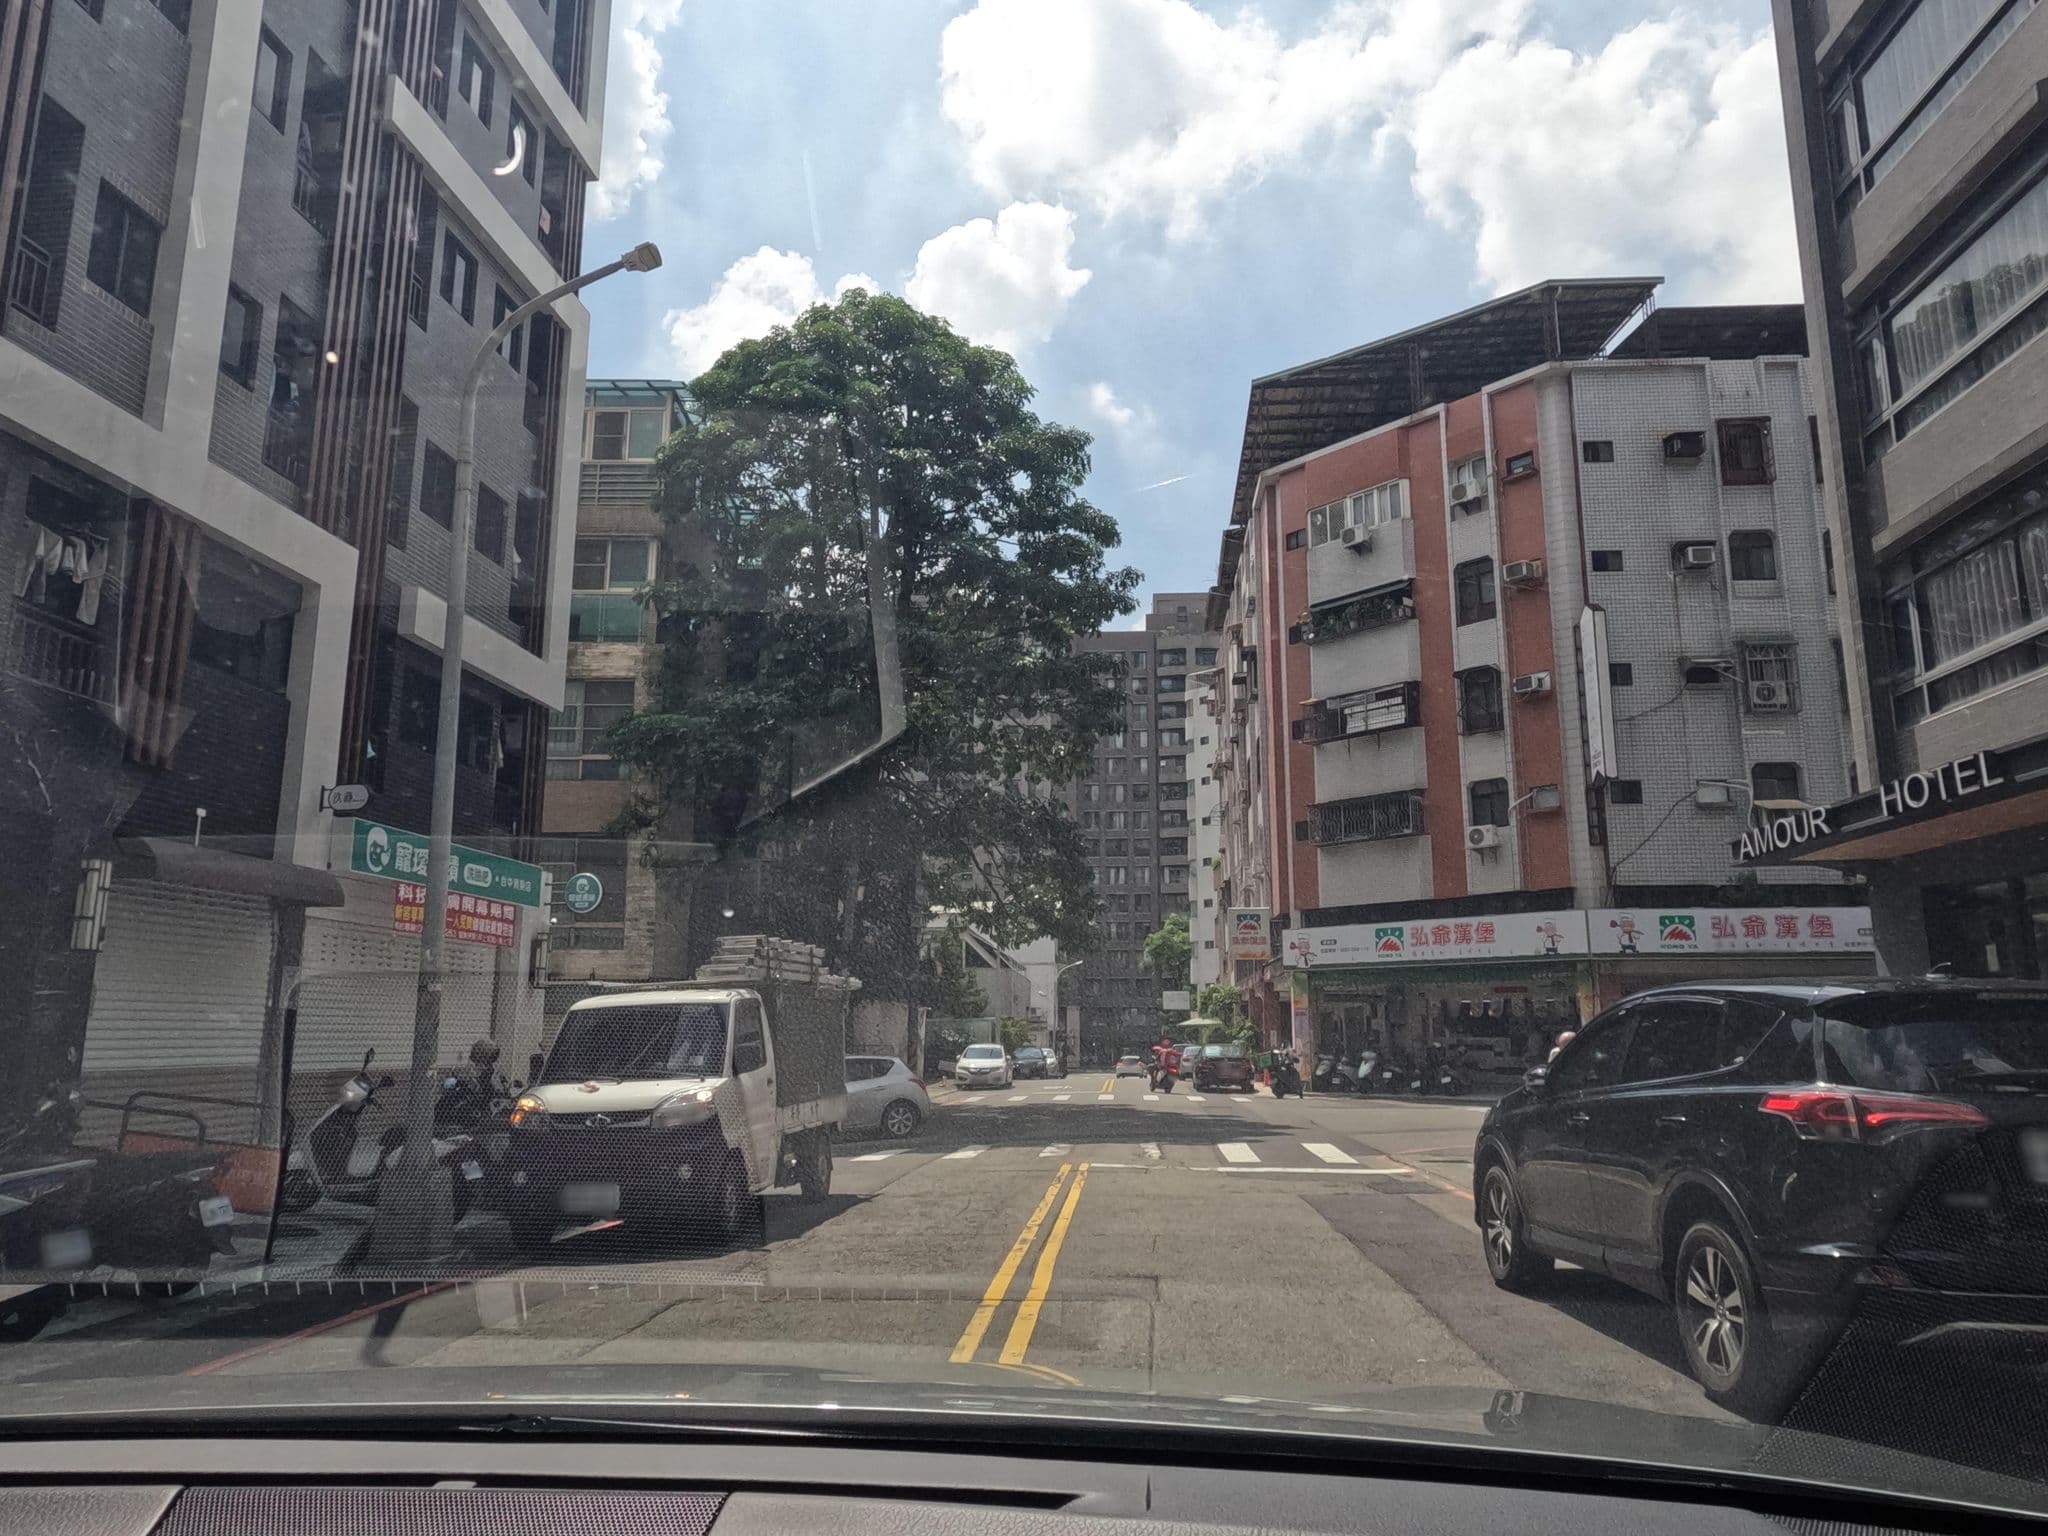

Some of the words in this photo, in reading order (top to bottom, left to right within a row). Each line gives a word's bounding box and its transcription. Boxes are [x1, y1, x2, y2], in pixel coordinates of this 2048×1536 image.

[1740, 806, 1832, 860] AMOUR
[1880, 750, 2004, 816] HOTEL
[1410, 921, 1497, 947] 弘爺漢堡
[1711, 913, 1835, 939] 弘爺漢堡
